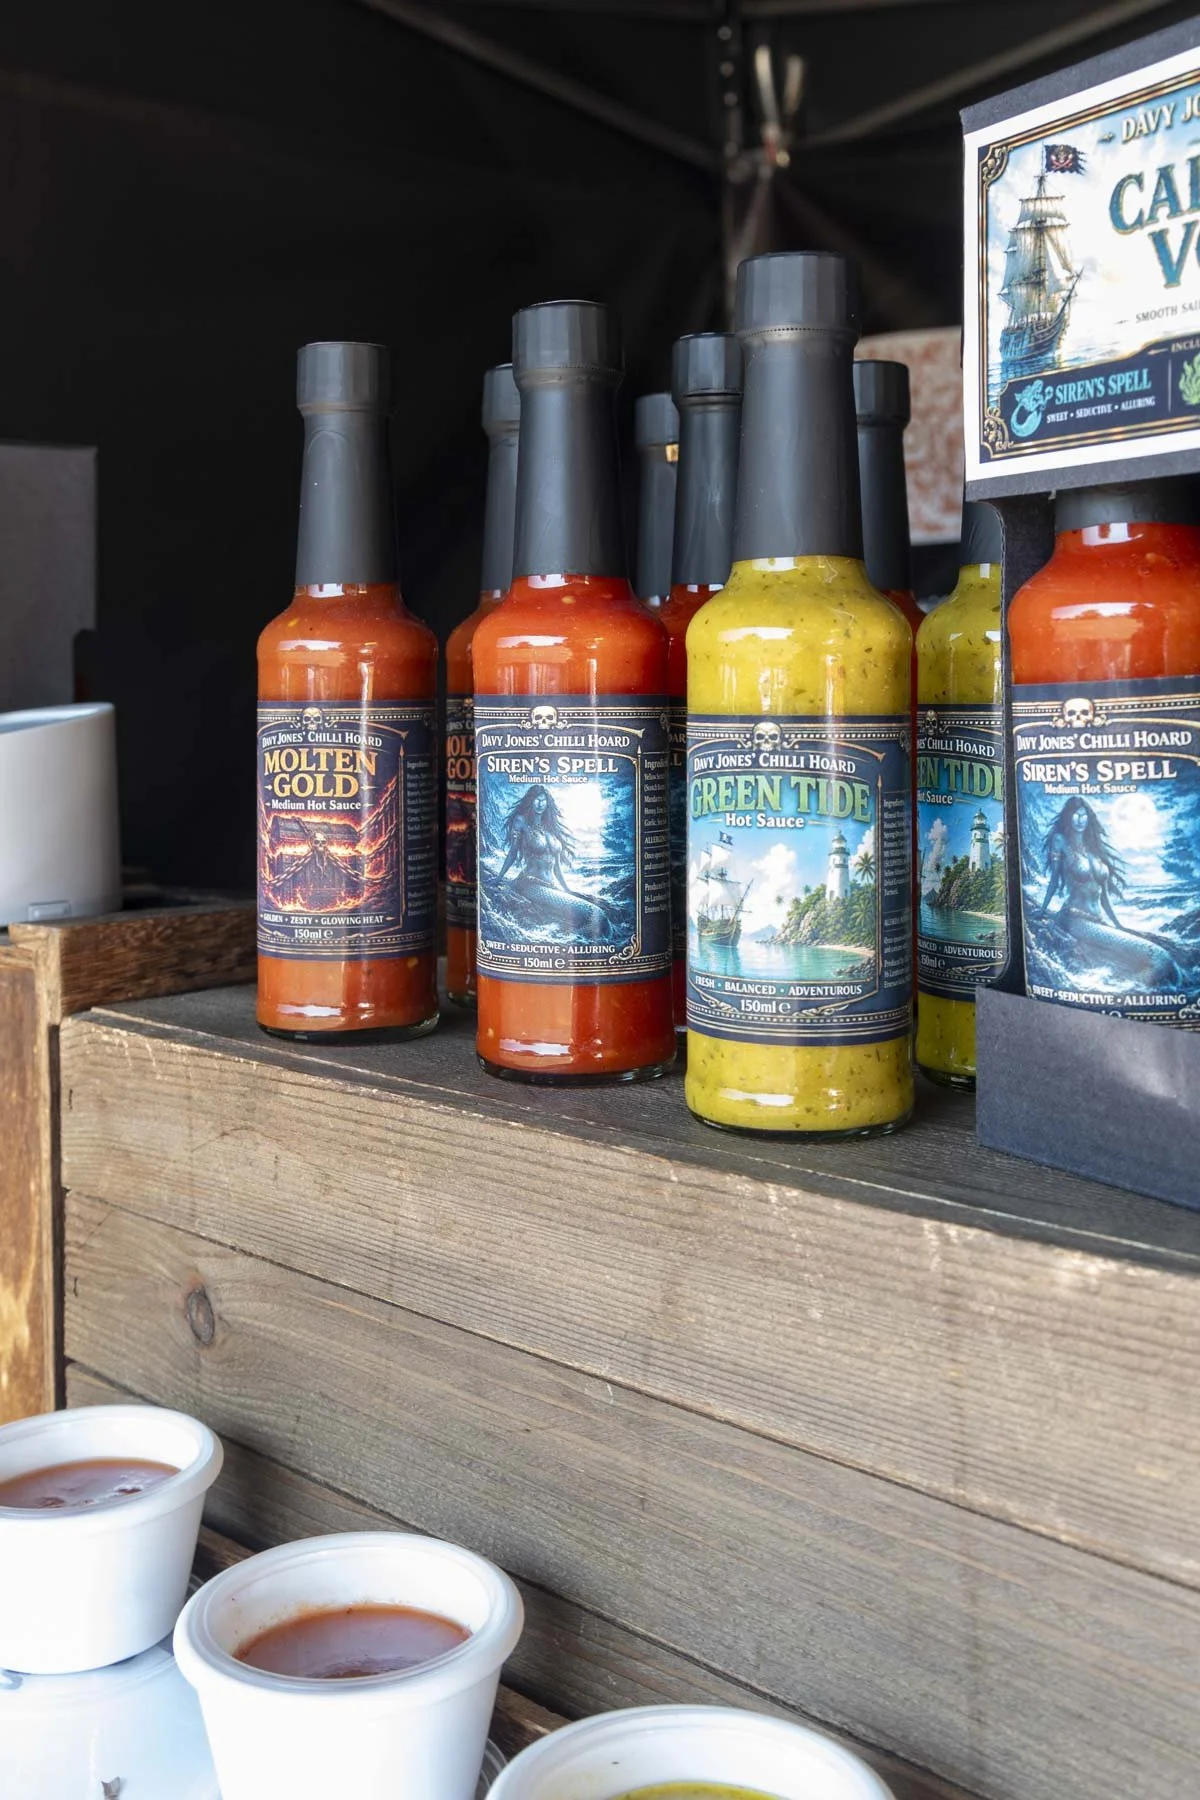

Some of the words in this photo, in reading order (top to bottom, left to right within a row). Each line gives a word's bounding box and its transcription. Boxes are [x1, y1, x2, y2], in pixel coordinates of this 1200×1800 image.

[1122, 102, 1177, 144] DAVY
[1148, 220, 1200, 289] V
[1136, 305, 1178, 323] SMOOTH
[1055, 376, 1105, 405] SIREN'S
[1108, 368, 1152, 396] SPELL
[1046, 411, 1068, 423] SWEET
[1075, 403, 1113, 418] SEDUCTIVE
[1120, 396, 1156, 411] ALLURING
[262, 736, 278, 748] DAVY
[277, 731, 306, 745] JONES'
[310, 731, 342, 743] CHILLI
[345, 732, 382, 747] HOARD
[482, 734, 502, 747] DAVY
[504, 734, 543, 748] JONES'
[544, 734, 585, 747] CHILLI
[588, 734, 630, 747] HOARD
[928, 738, 953, 751] CHILLI
[956, 740, 995, 757] HOARD
[1017, 734, 1037, 751] DAVY
[1038, 733, 1078, 751] JONES'
[1079, 732, 1130, 750] CHILLI
[1134, 730, 1192, 748] HOARD
[263, 748, 378, 776] MOLTEN
[487, 755, 550, 773] SIREN'S
[557, 756, 618, 773] SPELL
[694, 756, 715, 773] DAVY
[715, 753, 756, 770] JONES'
[759, 753, 805, 769] CHILLI
[810, 755, 856, 773] HOARD
[508, 774, 541, 783] Medium
[543, 774, 559, 783] Hot
[561, 774, 588, 783] Sauce
[1022, 761, 1089, 783] SIREN'S
[1097, 760, 1177, 781] SPELL
[273, 773, 359, 798] GOLD
[1045, 783, 1080, 794] Medium
[1081, 783, 1101, 794] Hot
[1103, 783, 1137, 794] Sauce
[271, 799, 305, 810] Medium
[307, 799, 326, 810] Hot
[329, 799, 361, 811] Sauce
[690, 775, 782, 819] GREEN
[790, 775, 872, 823] TIDE
[926, 791, 953, 804] Sauce
[725, 813, 752, 828] Hot
[756, 813, 804, 828] Sauce
[263, 913, 283, 922] GOLDEN
[290, 916, 312, 925] ZESTY
[321, 916, 361, 925] GLOWING
[363, 915, 384, 924] HEAT
[294, 929, 322, 939] 150ml
[485, 939, 505, 951] SWEET
[511, 943, 560, 954] SEDUCTIVE
[567, 944, 616, 954] ALLURING
[944, 945, 1003, 959] ADVENTUROUS
[523, 957, 552, 968] 150ml
[695, 975, 715, 988] FRESH
[724, 981, 776, 995] BALANCED
[788, 984, 862, 996] ADVENTUROUS
[1032, 984, 1054, 998] SWEET
[1058, 990, 1114, 1005] SEDUCTIVE
[1124, 994, 1187, 1006] ALLURING
[740, 1000, 777, 1014] 150ml
